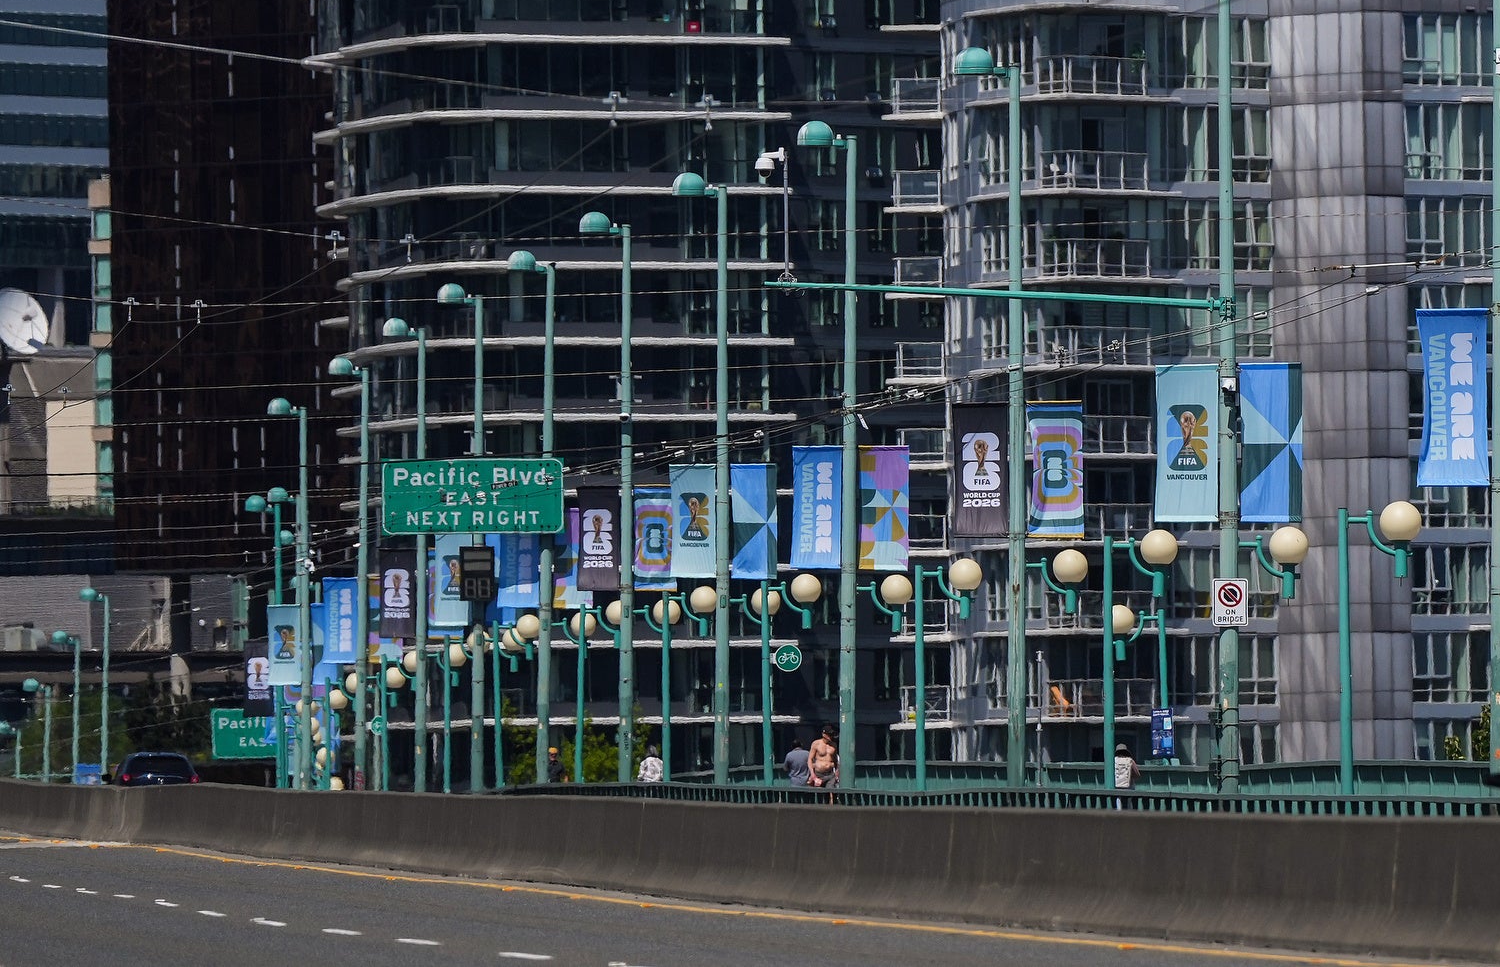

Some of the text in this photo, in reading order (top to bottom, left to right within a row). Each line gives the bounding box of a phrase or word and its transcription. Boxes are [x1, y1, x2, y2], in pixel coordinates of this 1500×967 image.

[1450, 332, 1474, 386] WE
[1428, 333, 1448, 461] VANCOUVER
[1177, 457, 1198, 466] FIFA
[393, 467, 480, 486] Pacific
[816, 461, 833, 500] WE
[973, 478, 991, 486] FIFA
[1166, 473, 1208, 481] VANCOUVER
[445, 491, 501, 506] EAST
[962, 499, 1001, 508] 2026
[799, 462, 814, 553] VANCOUVER
[406, 510, 539, 526] NEXT RIGHT
[583, 560, 614, 569] 2026
[218, 717, 266, 730] Pacifi
[239, 736, 269, 747] EAS
